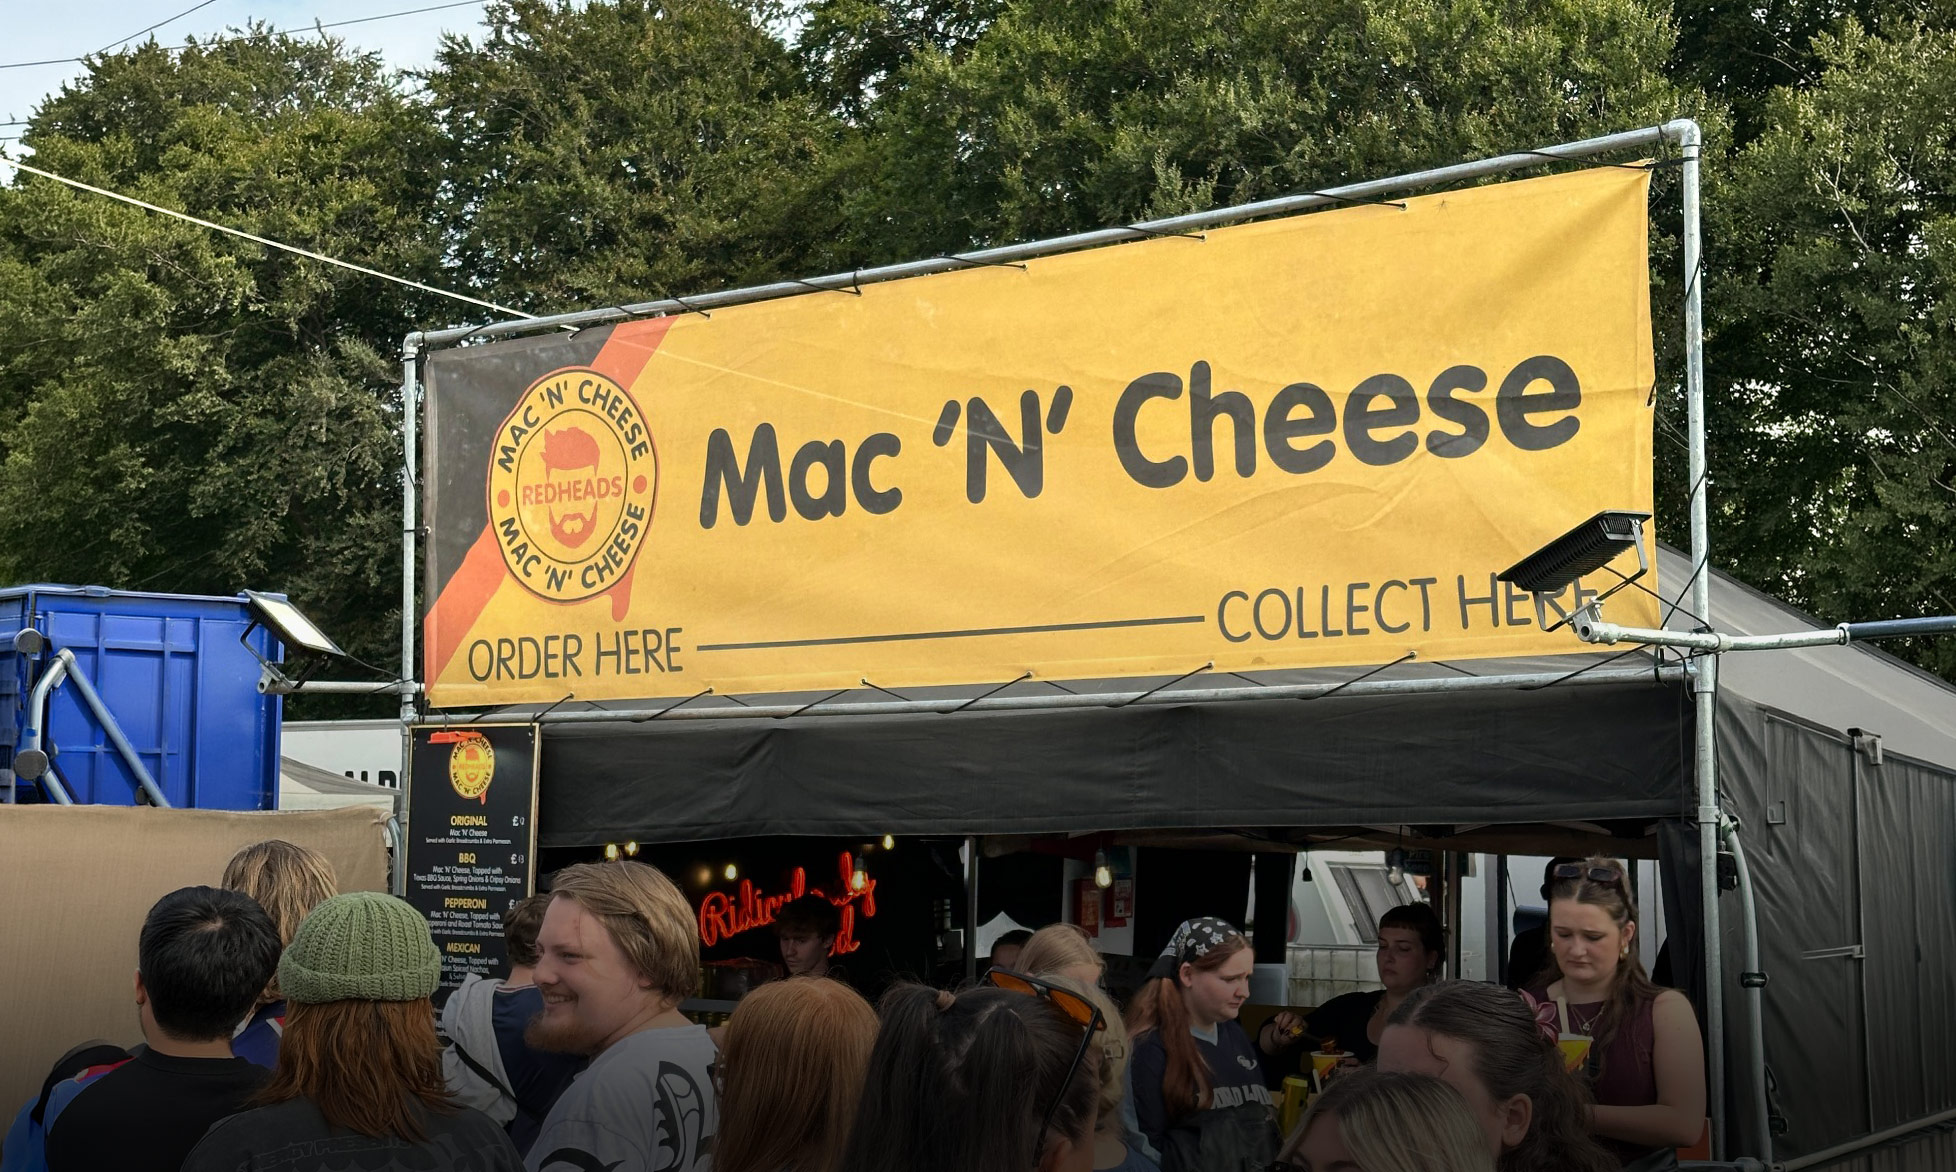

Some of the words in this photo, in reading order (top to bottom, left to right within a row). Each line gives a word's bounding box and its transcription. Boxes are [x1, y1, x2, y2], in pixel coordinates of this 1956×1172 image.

[499, 405, 540, 473] MAC
[540, 380, 568, 410] 'N'
[578, 380, 649, 461] CHEESE
[700, 422, 903, 529] Mac
[933, 385, 1073, 504] 'N'
[1112, 355, 1582, 489] Cheese
[523, 476, 623, 507] REDHEADS
[500, 517, 541, 578] MAC
[545, 565, 573, 593] 'N'
[581, 503, 645, 589] CHEESE
[1217, 577, 1437, 643] COLLECT
[468, 634, 583, 682] ORDER
[596, 628, 683, 676] HERE
[450, 815, 488, 826] ORIGINAL
[450, 829, 461, 837] Mac
[469, 829, 488, 837] Cheese
[459, 852, 476, 864] BBQ
[433, 866, 444, 874] Mac
[413, 873, 427, 881] Texas
[427, 874, 437, 882] BBQ
[453, 874, 467, 884] Spring
[468, 875, 484, 883] Onions
[504, 876, 521, 884] Onions
[444, 898, 487, 909] PEPPERONI
[489, 912, 500, 920] with
[473, 921, 491, 929] Tomato
[446, 942, 480, 953] MEXICAN
[488, 957, 499, 965] with
